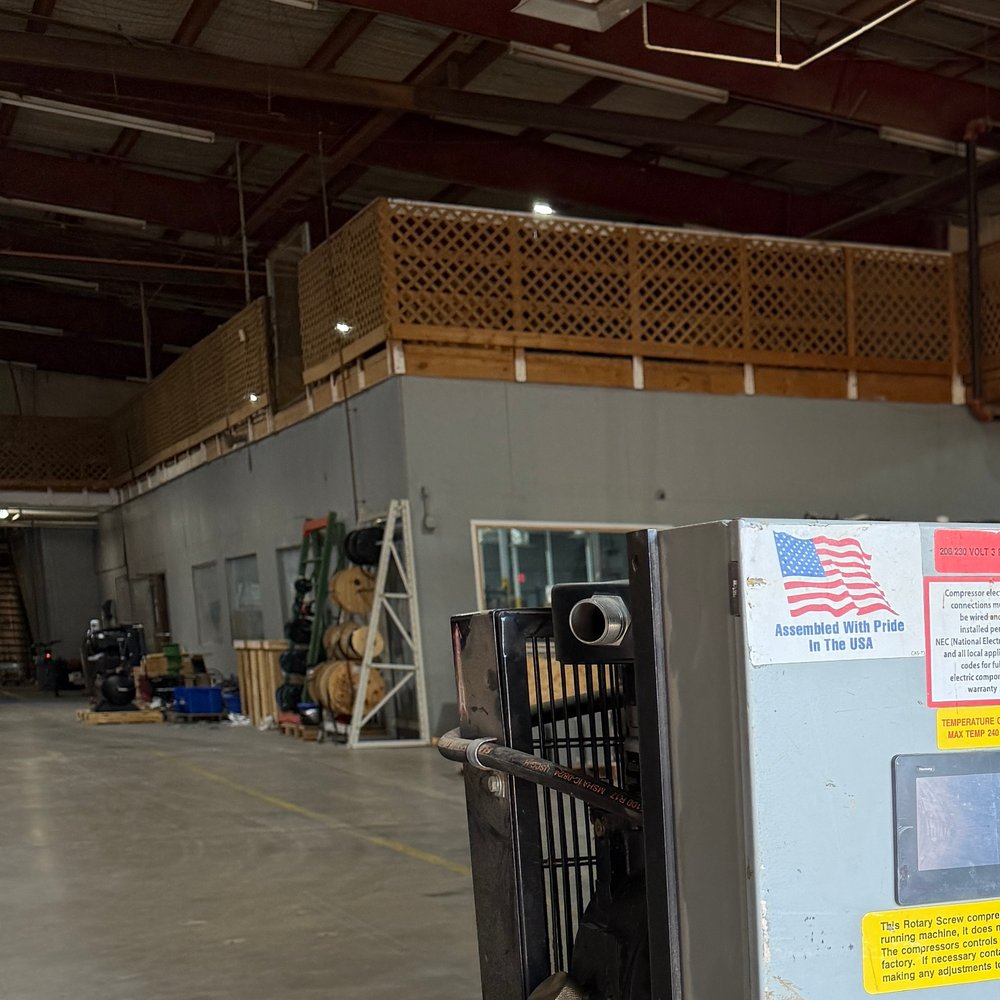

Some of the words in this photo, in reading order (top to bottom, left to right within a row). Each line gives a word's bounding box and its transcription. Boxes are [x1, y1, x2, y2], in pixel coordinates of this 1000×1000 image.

[969, 548, 988, 556] VOLT
[991, 548, 996, 556] 3
[944, 589, 984, 598] Compressor
[950, 601, 992, 609] connections
[960, 613, 968, 621] be
[970, 613, 988, 621] wired
[775, 622, 840, 637] Assembled
[843, 620, 870, 634] With
[874, 619, 905, 632] Pride
[960, 625, 989, 633] installed
[809, 639, 820, 652] In
[824, 638, 846, 651] The
[850, 637, 873, 650] USA
[935, 638, 950, 646] NEC
[950, 637, 981, 646] (National
[967, 649, 983, 657] local
[960, 661, 980, 669] codes
[950, 673, 974, 682] electric
[968, 686, 998, 694] warranty
[942, 717, 994, 727] TEMPERATURE
[948, 730, 963, 739] MAX
[966, 730, 985, 738] TEMP
[988, 729, 999, 737] 240
[880, 921, 900, 931] This
[903, 918, 933, 930] Rotary
[936, 916, 964, 926] Screw
[880, 933, 916, 945] running
[919, 928, 960, 941] machine,
[962, 926, 968, 936] it
[971, 924, 993, 934] does
[881, 947, 898, 957] The
[901, 940, 960, 956] compressors
[962, 936, 998, 946] controls
[881, 958, 916, 970] factory.
[922, 955, 929, 965] If
[931, 950, 977, 964] necessary
[882, 970, 915, 983] making
[918, 969, 935, 980] any
[938, 962, 992, 977] adjustments
